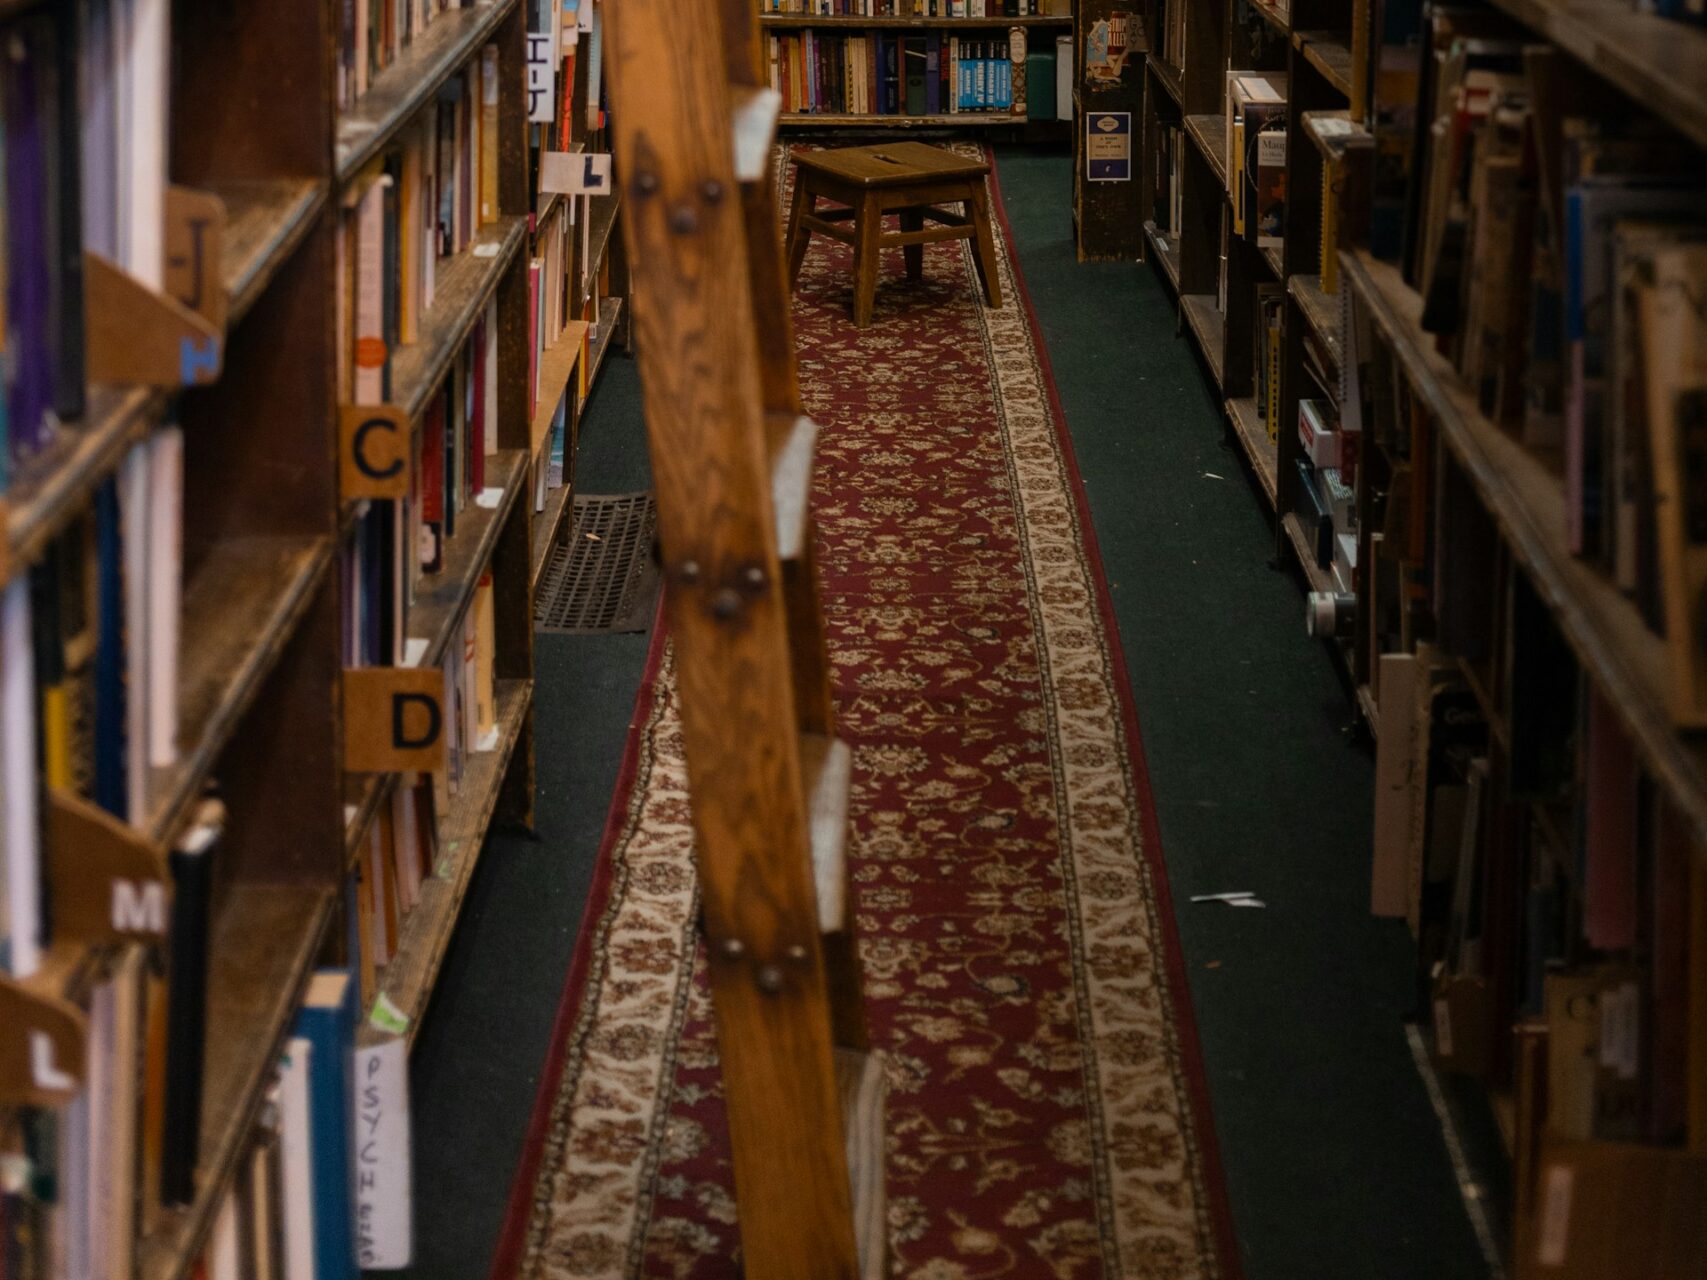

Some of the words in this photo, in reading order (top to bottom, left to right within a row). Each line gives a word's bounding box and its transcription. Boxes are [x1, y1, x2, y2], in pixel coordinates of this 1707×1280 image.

[977, 94, 984, 103] IV
[583, 155, 603, 188] L
[179, 334, 218, 386] H
[351, 418, 405, 480] C
[392, 693, 441, 749] D
[112, 878, 165, 932] M
[30, 1029, 76, 1090] L
